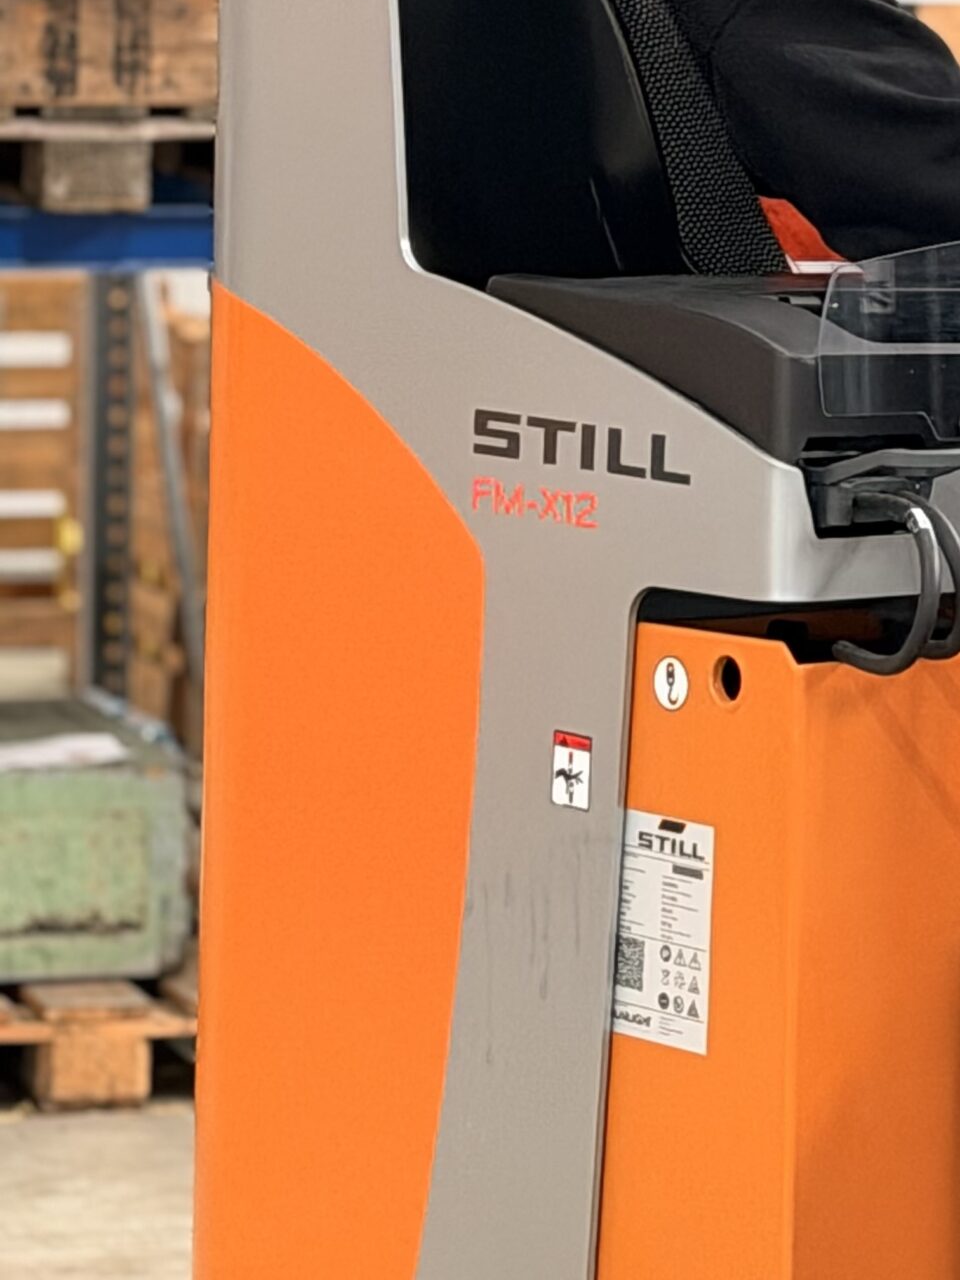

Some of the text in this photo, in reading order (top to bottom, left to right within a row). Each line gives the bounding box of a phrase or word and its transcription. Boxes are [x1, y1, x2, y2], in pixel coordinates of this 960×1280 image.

[473, 408, 691, 486] STILL
[471, 475, 599, 529] FM-X12
[638, 831, 705, 861] STILL
